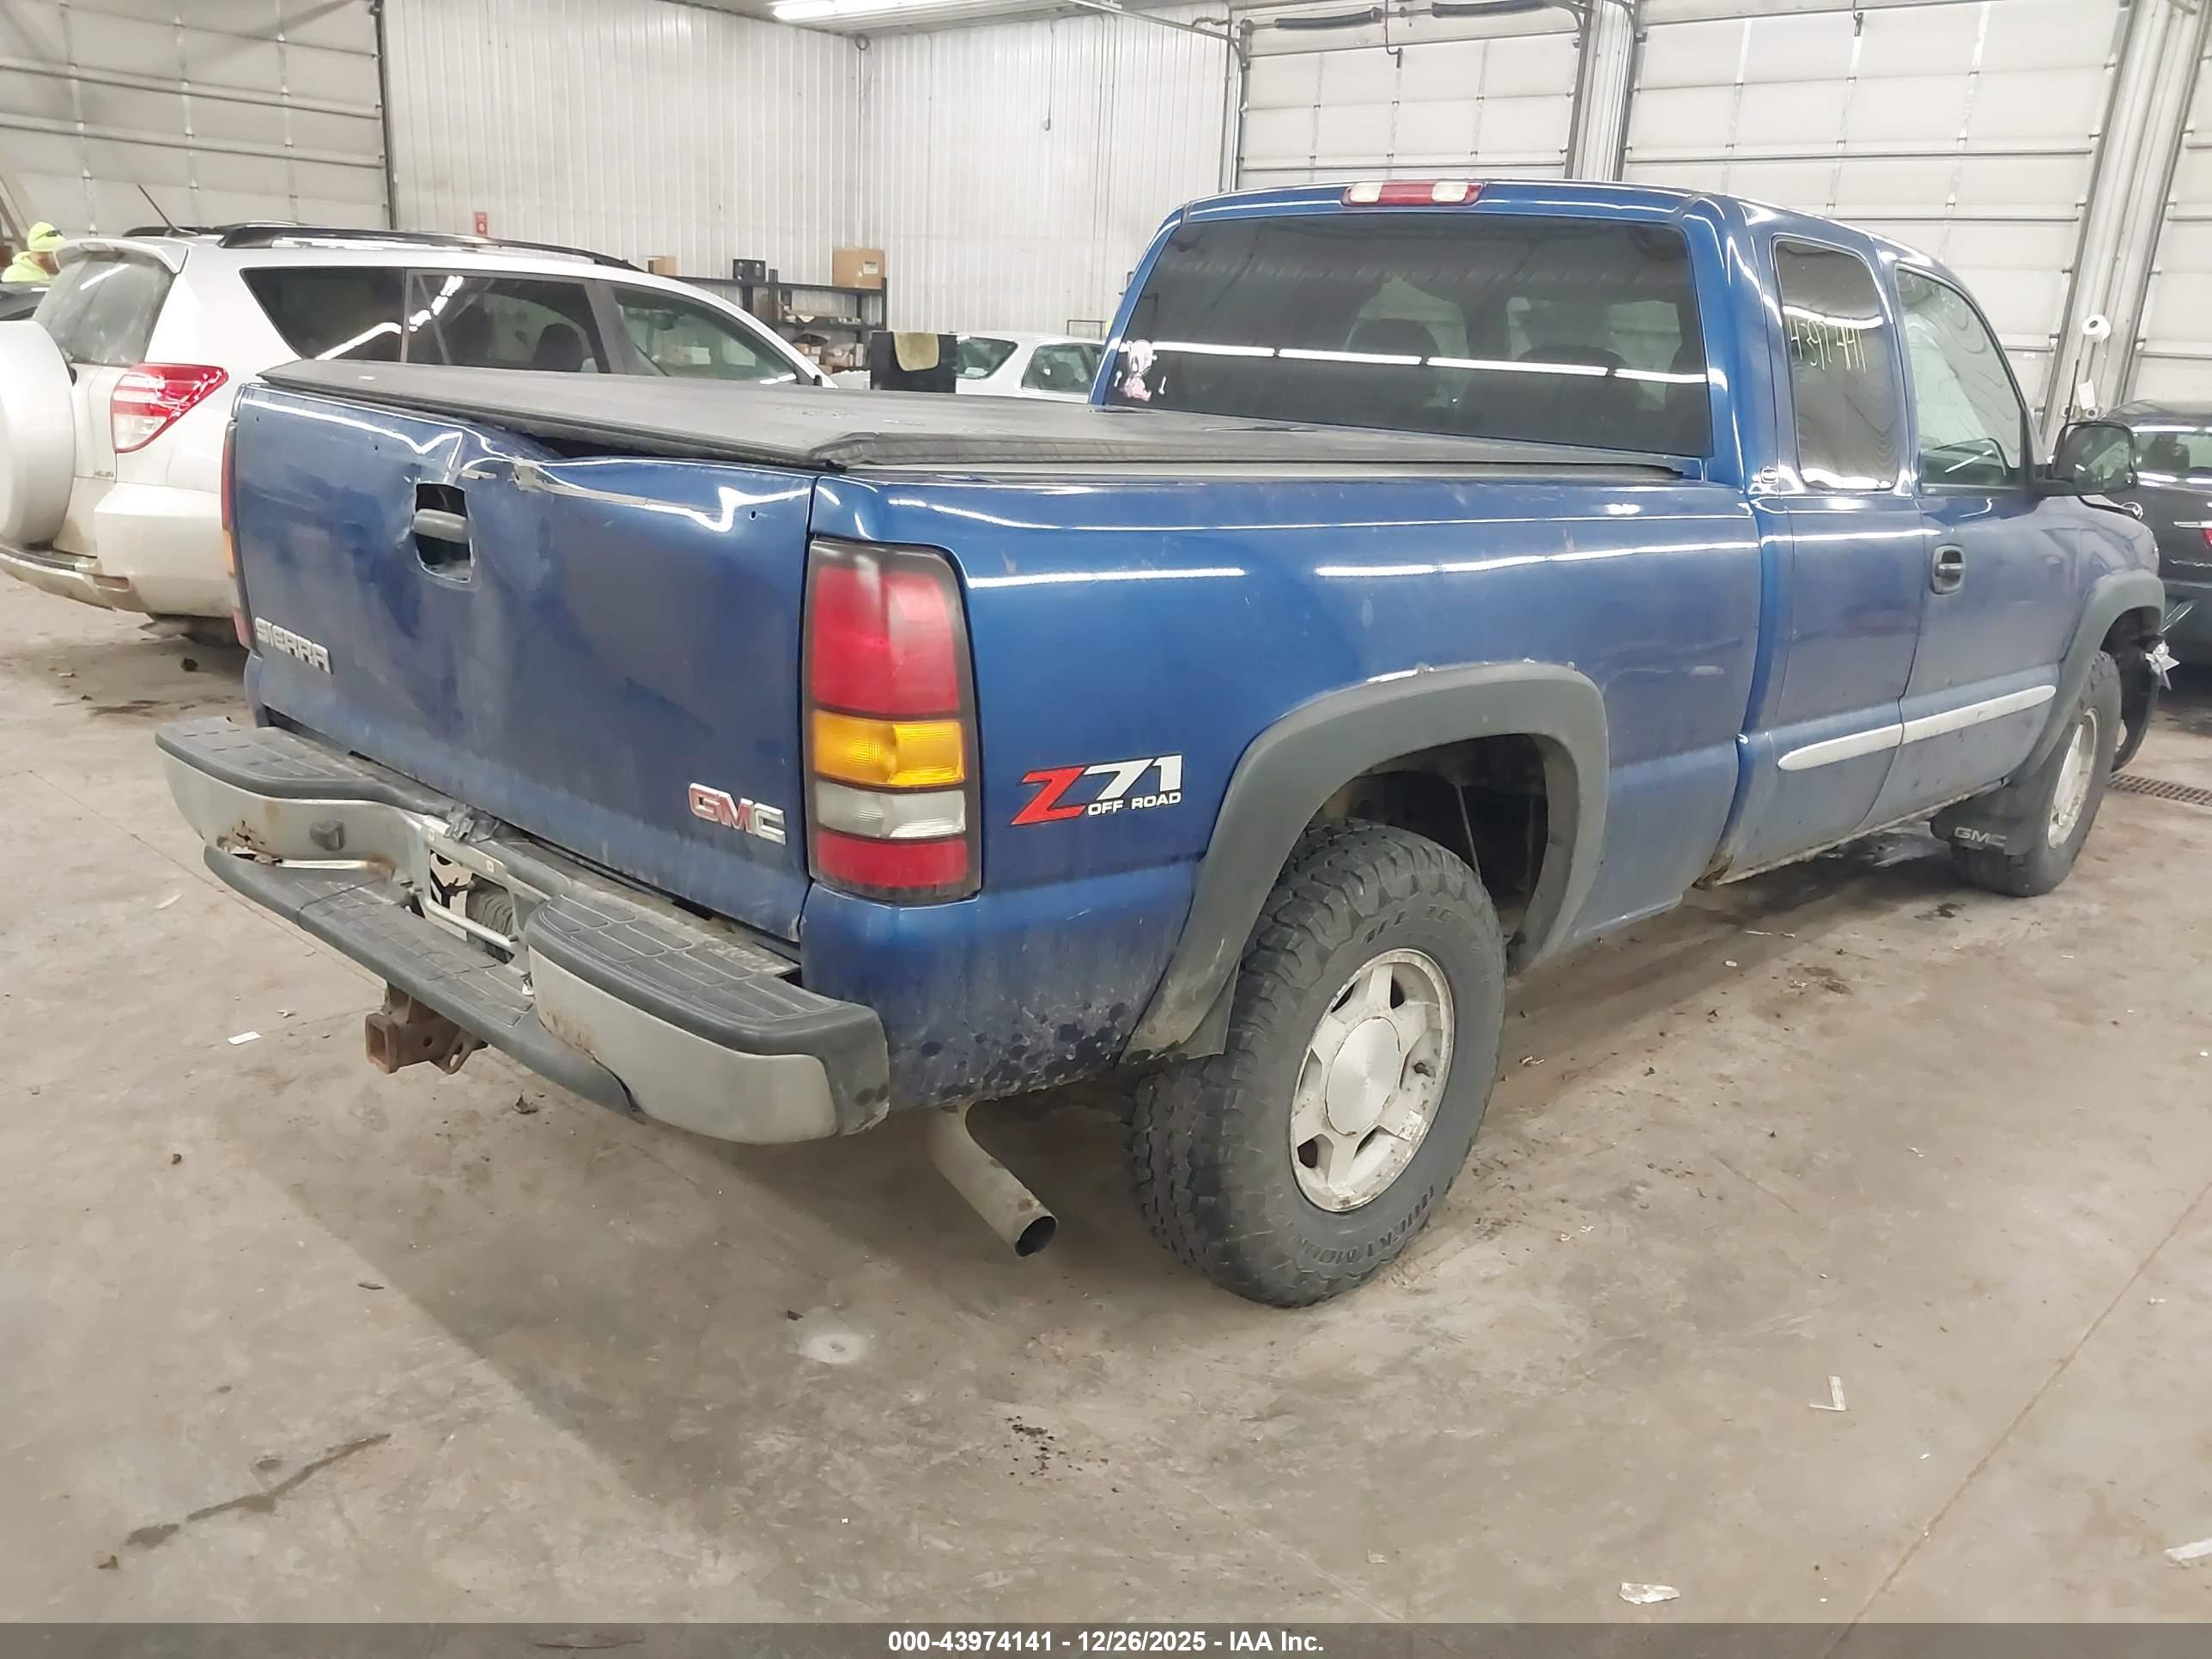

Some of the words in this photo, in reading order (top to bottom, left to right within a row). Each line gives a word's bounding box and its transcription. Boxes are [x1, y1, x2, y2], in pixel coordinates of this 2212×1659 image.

[254, 617, 331, 674] SIERRA
[688, 781, 787, 845] GMC
[1010, 753, 1182, 826] Z71
[1087, 799, 1124, 817] OFF
[1131, 791, 1182, 810] ROAD
[1954, 826, 2007, 848] GMC
